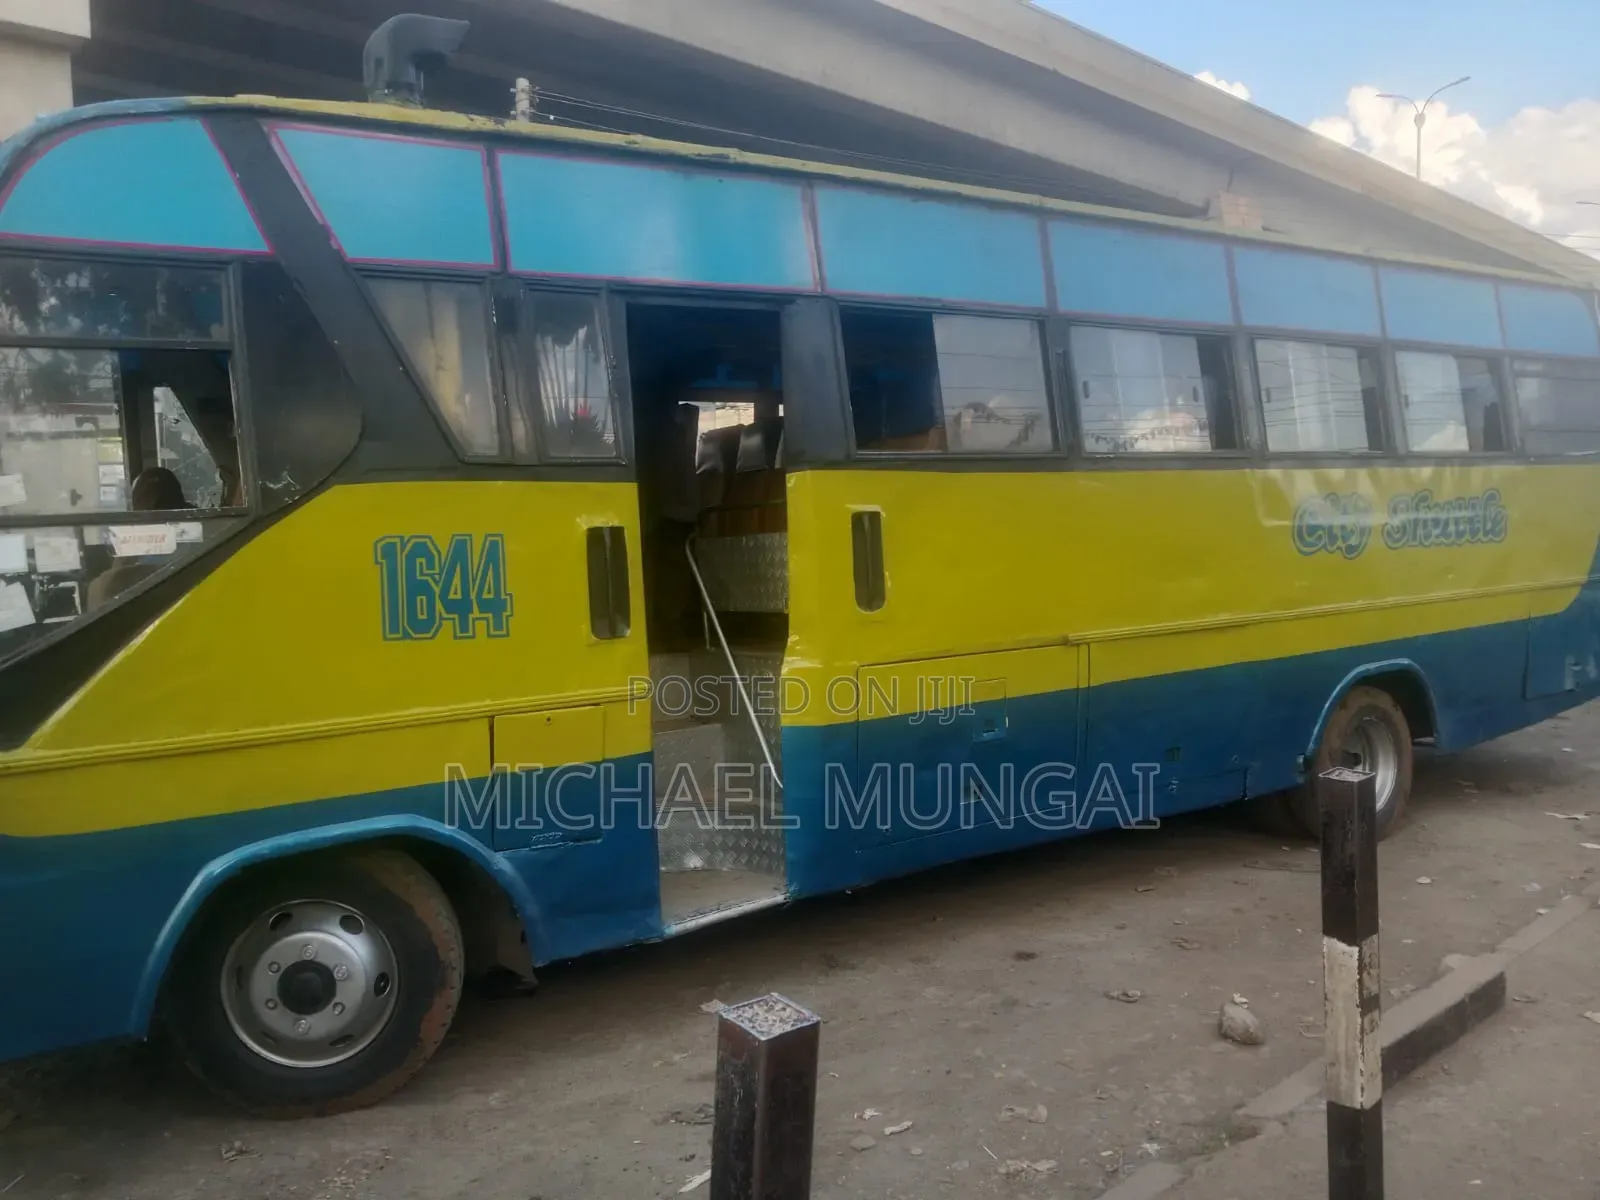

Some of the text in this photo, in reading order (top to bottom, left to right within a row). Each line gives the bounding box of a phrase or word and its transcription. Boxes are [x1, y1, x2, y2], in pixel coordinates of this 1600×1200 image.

[1293, 488, 1508, 560] City Shuttle
[374, 533, 514, 641] 1644
